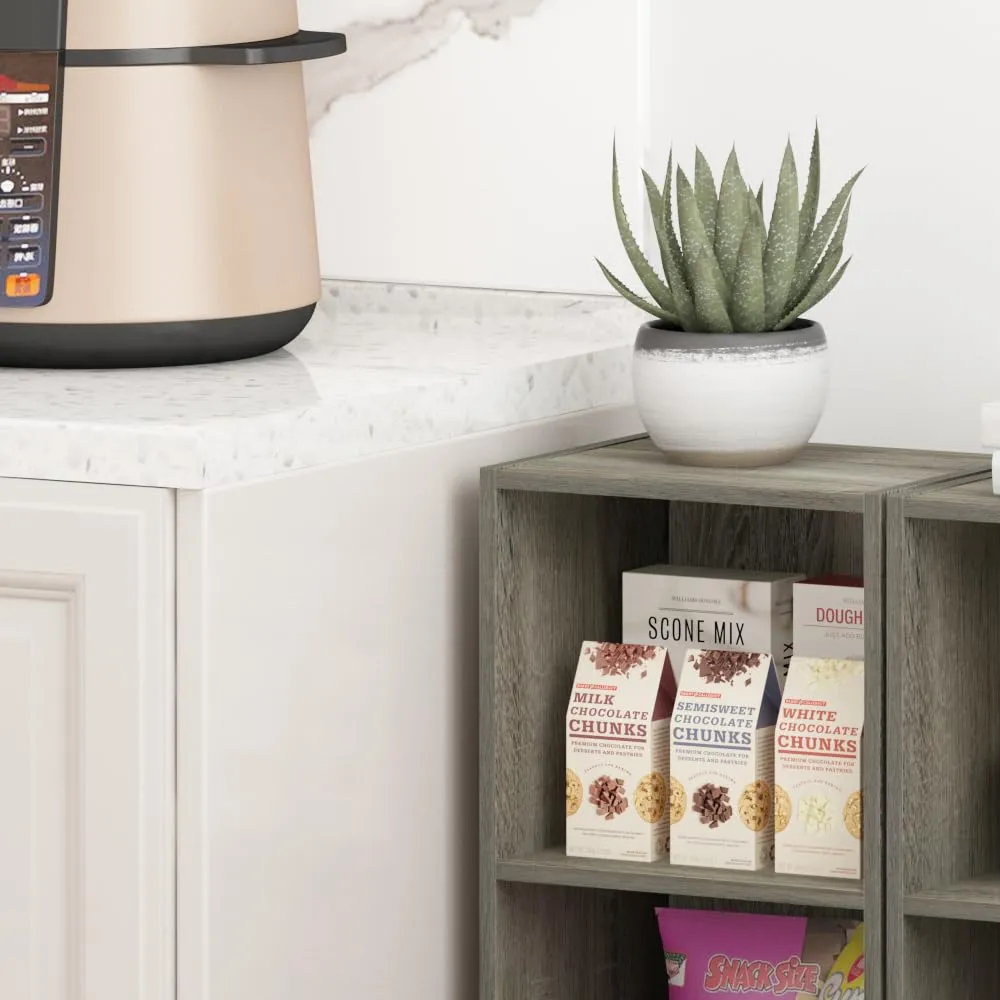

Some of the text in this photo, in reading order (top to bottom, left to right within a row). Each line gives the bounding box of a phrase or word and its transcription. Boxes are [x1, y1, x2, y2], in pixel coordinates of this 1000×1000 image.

[816, 607, 863, 625] DOUGH
[648, 616, 744, 645] SCONE MIX
[573, 692, 615, 705] MILK
[571, 706, 649, 720] CHOCOLATE
[677, 702, 756, 716] SEMISWEET
[783, 707, 837, 722] WHITE
[569, 719, 647, 737] CHUNKS
[674, 714, 753, 728] CHOCOLATE
[779, 722, 859, 736] CHOCOLATE
[673, 727, 751, 745] CHUNKS
[777, 735, 857, 753] CHUNKS
[704, 954, 775, 993] SNACK
